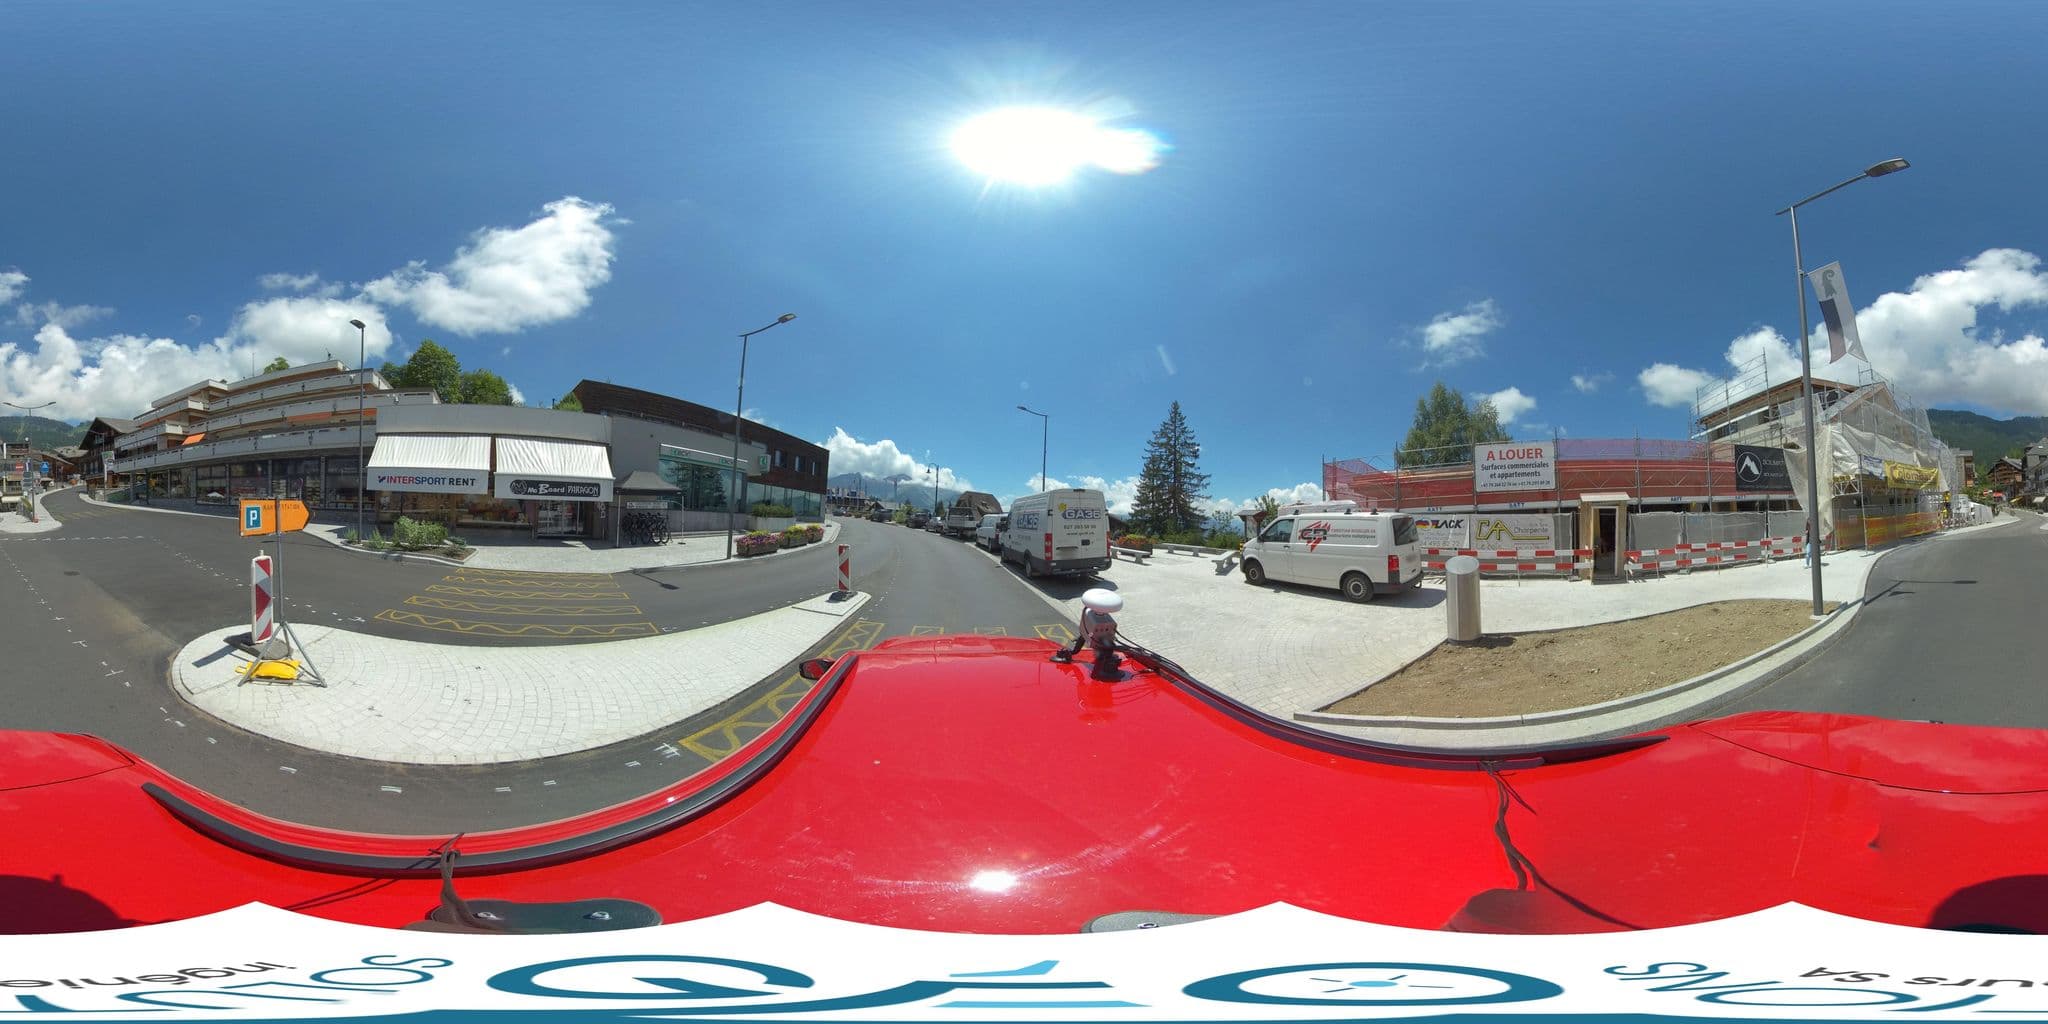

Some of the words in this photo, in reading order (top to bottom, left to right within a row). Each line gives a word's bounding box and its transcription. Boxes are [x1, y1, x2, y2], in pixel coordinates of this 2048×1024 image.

[1487, 450, 1495, 461] A
[1499, 448, 1543, 460] LOUER
[1481, 463, 1506, 472] Surfaces
[1507, 461, 1549, 470] commerciales
[387, 475, 446, 486] INTERSPORT
[449, 478, 476, 486] RENT
[1498, 471, 1541, 479] appartements
[539, 483, 565, 494] Board
[568, 485, 599, 495] PARAGON
[250, 510, 257, 526] P
[1065, 510, 1100, 519] GA36
[1514, 526, 1548, 534] Charpente
